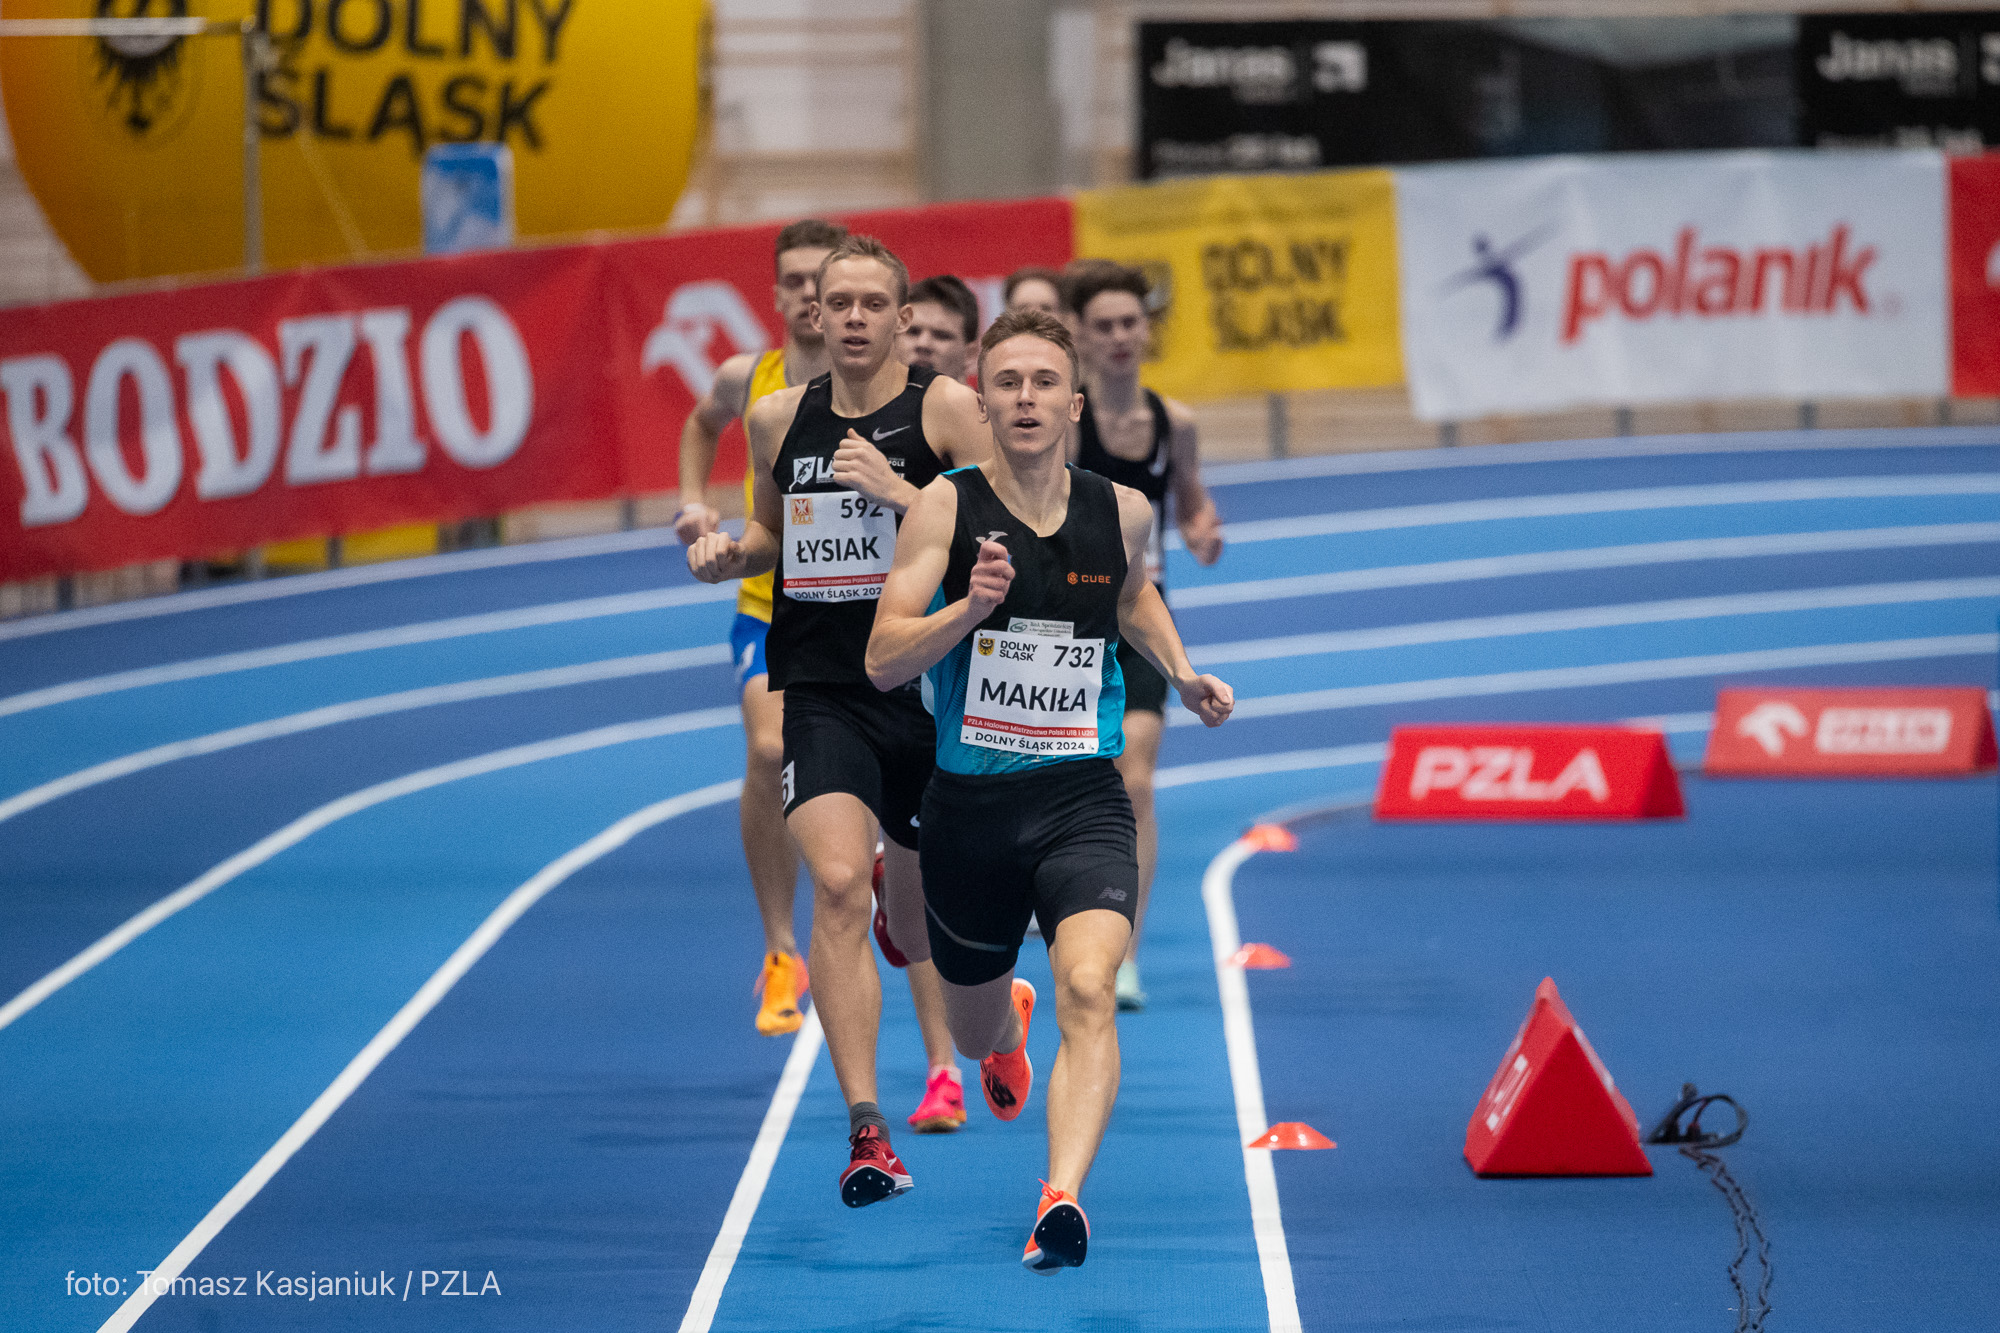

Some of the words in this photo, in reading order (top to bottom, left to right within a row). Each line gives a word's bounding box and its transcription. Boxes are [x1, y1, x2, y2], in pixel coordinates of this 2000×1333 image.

[257, 0, 575, 65] DOLNY
[1559, 223, 1877, 343] polanik
[1, 296, 533, 526] BODZIO
[841, 498, 883, 518] 592
[796, 536, 880, 563] ŁYSIAK
[1081, 575, 1111, 584] CUBE
[795, 591, 825, 599] DOLNY
[827, 588, 860, 599] ŚLĄSK
[862, 587, 882, 596] 202
[1000, 640, 1038, 652] DOLNY
[1053, 645, 1095, 668] 732
[979, 677, 1088, 711] MAKIŁA
[967, 718, 983, 726] PZLA
[984, 721, 1009, 730] Halowe
[975, 732, 1016, 746] DOLNY
[1018, 737, 1054, 752] ŚLĄSK
[1056, 741, 1085, 750] 2024
[1410, 746, 1611, 802] PZLA
